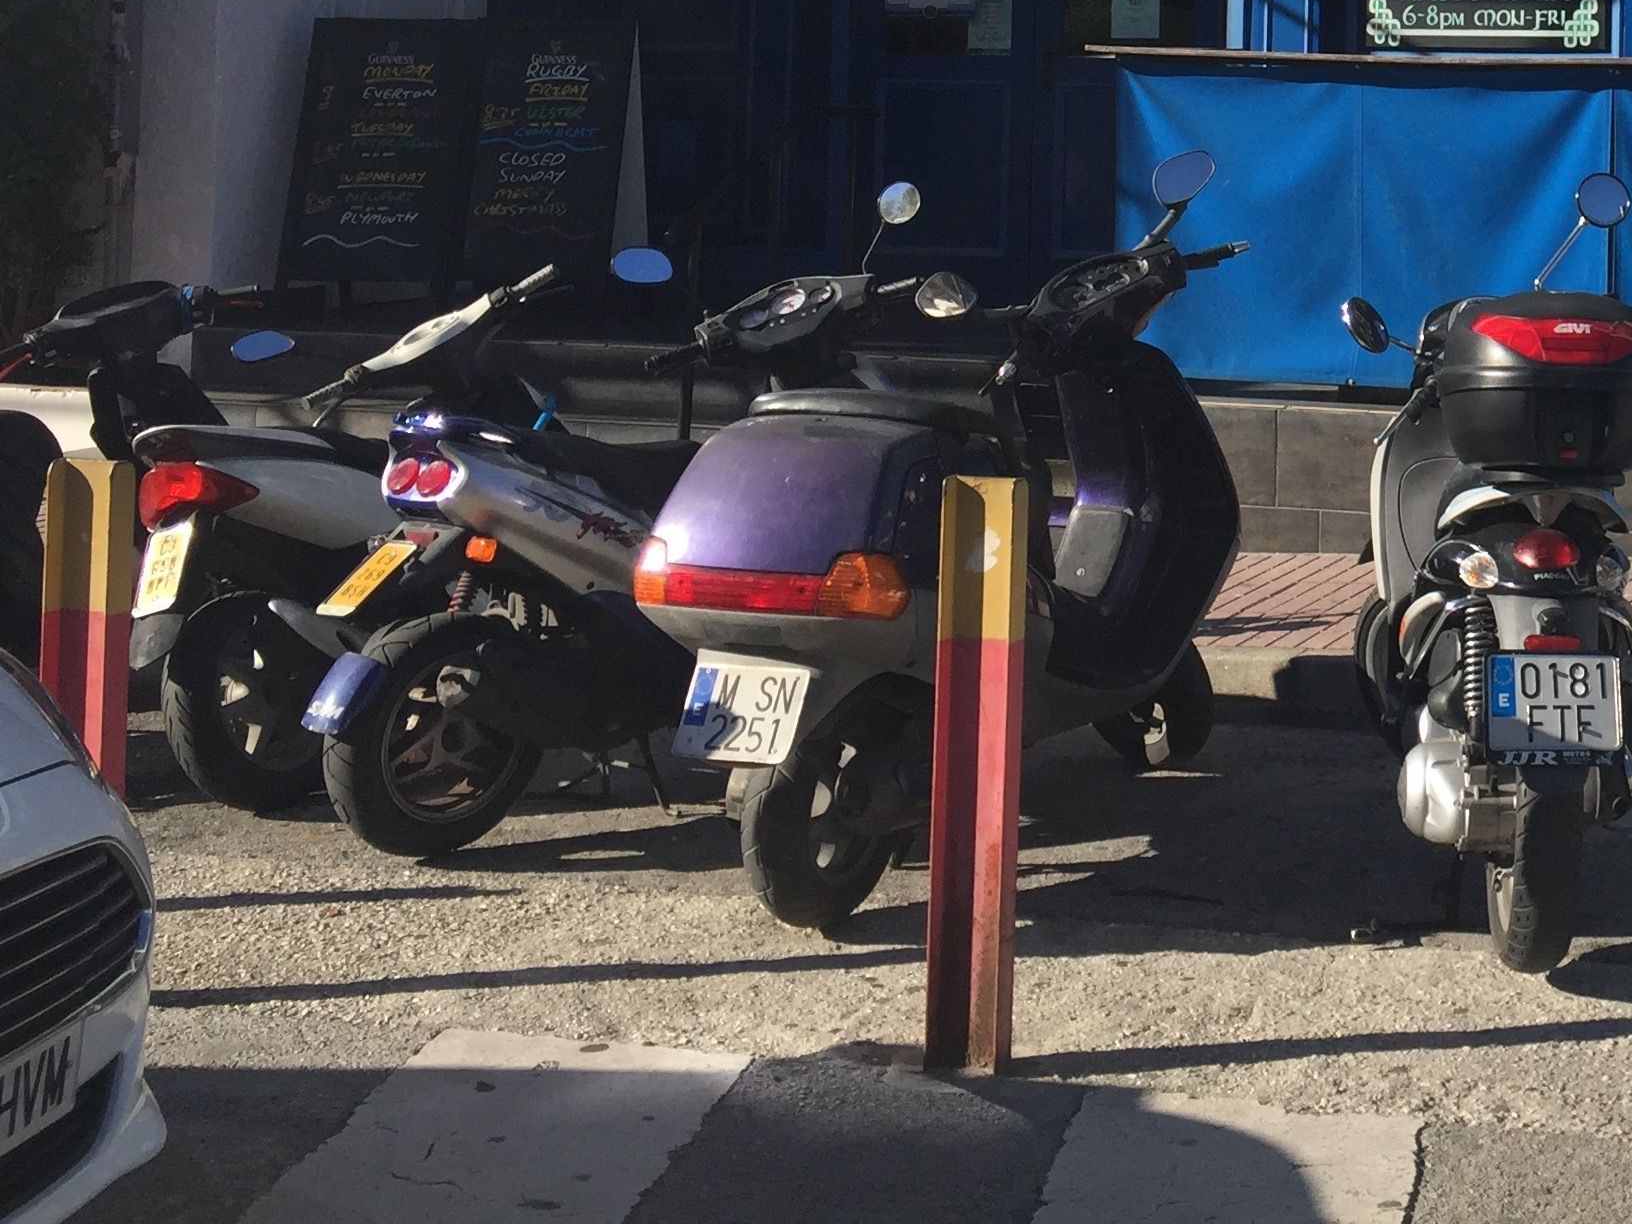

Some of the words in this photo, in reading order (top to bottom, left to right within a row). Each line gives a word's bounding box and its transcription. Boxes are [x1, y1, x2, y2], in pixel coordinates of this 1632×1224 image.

[525, 63, 588, 77] RUGBY
[362, 86, 438, 100] EVERTON
[528, 82, 589, 97] FRIDAY
[526, 105, 586, 120] ULSTER
[498, 152, 566, 167] CLOSED
[498, 167, 567, 184] SUNDAY
[339, 210, 419, 226] PLYMOUTH
[1520, 662, 1607, 700] 0181
[716, 674, 741, 712] M
[755, 676, 800, 715] SN
[703, 714, 781, 756] 2251
[1497, 751, 1559, 766] JJR
